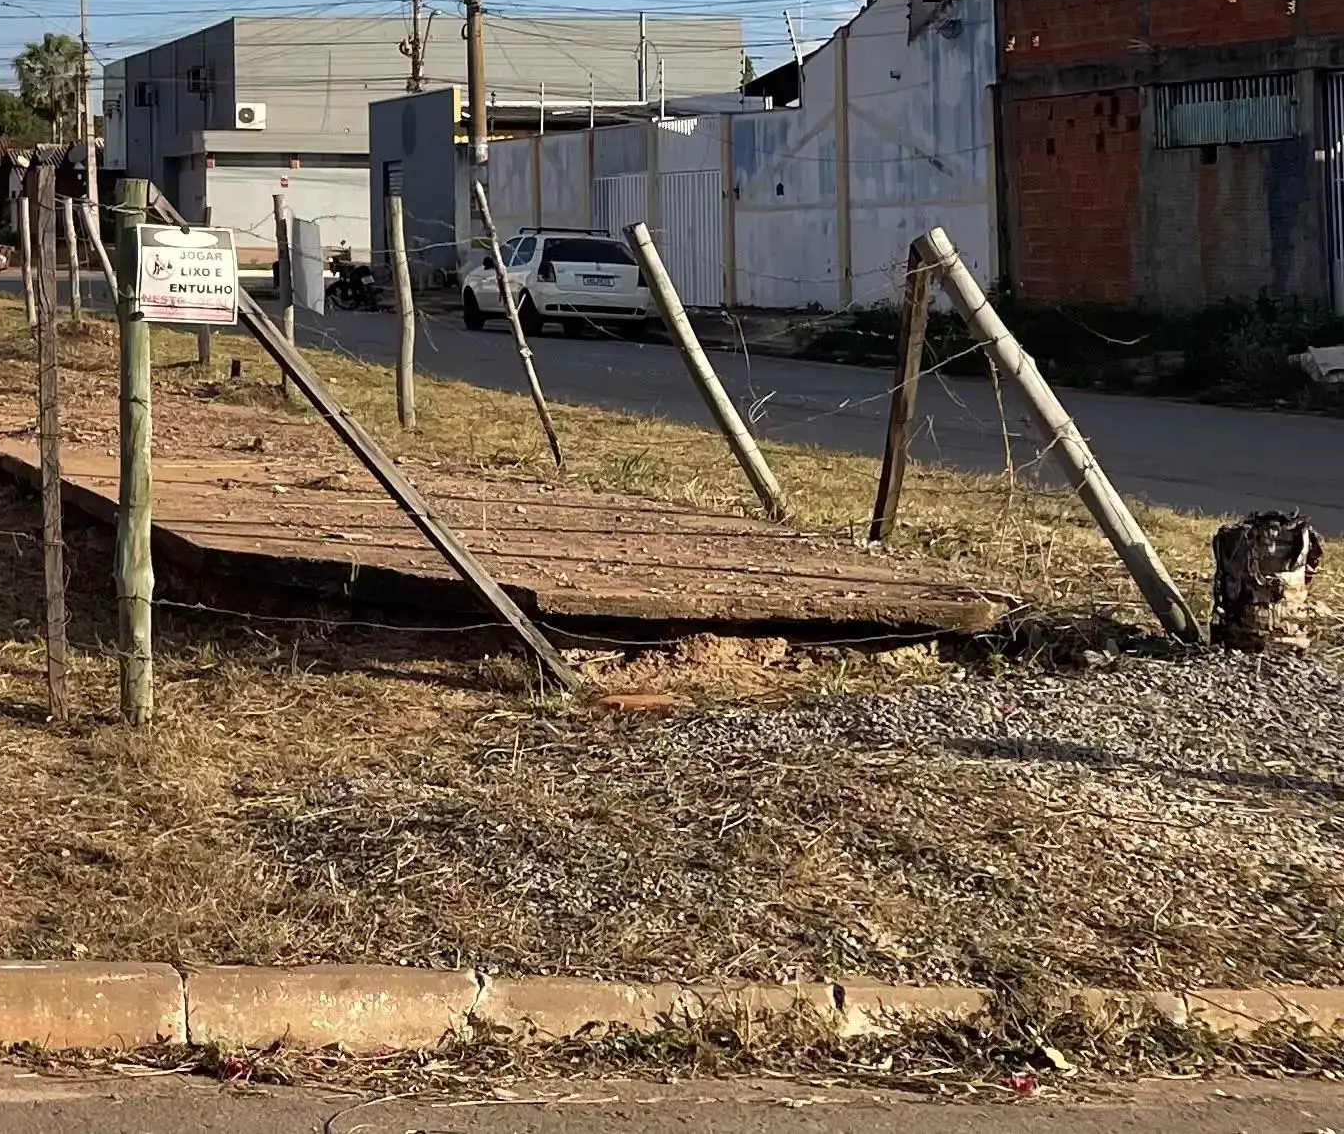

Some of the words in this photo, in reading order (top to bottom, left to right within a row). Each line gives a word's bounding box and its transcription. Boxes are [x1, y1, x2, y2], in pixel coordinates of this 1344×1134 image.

[180, 251, 223, 261] JOGAR
[180, 268, 211, 277] LIXO
[215, 268, 222, 277] E
[169, 283, 233, 294] ENTULHO
